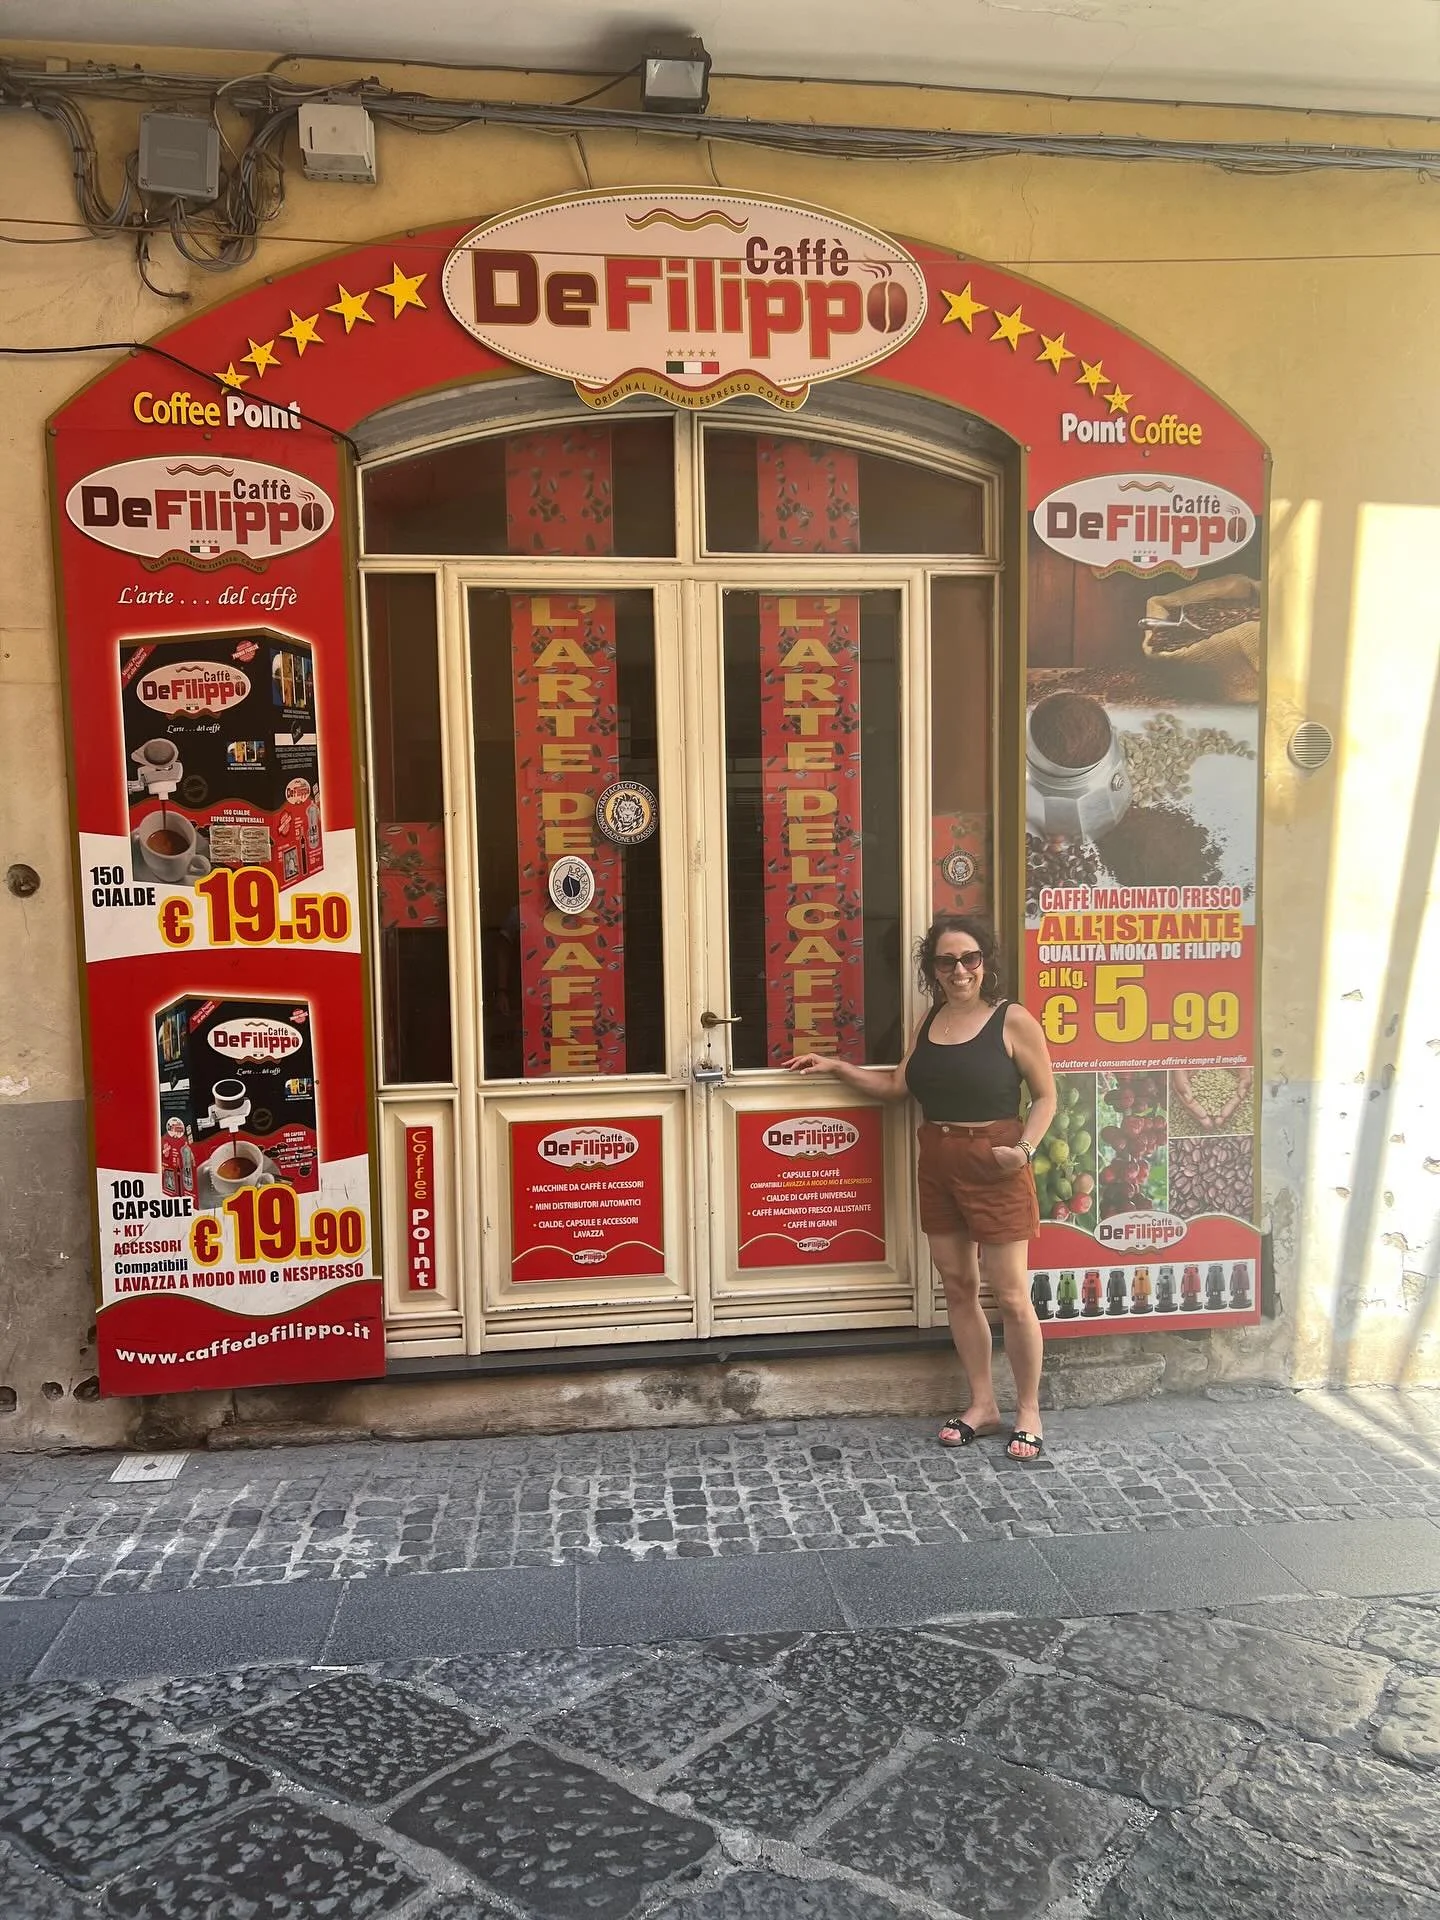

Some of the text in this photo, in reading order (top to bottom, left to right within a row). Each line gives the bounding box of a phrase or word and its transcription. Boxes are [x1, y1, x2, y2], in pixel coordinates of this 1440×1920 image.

[746, 236, 849, 276] Caffè
[594, 381, 796, 409] ORIGINAL ITALIAN ESPRESSO COFFEE
[134, 391, 303, 430] Coffee Point
[1062, 413, 1202, 445] Point Coffee
[233, 478, 291, 499] Caffè
[1172, 494, 1221, 514] Caffè
[117, 585, 174, 604] L'arte
[218, 586, 250, 605] del
[251, 586, 297, 610] caffè
[90, 865, 124, 886] 150
[92, 887, 156, 907] CIALDE
[160, 867, 350, 946] € 19.50
[1041, 886, 1242, 910] CAFFÈ MACINATO FRESCO
[1038, 912, 1242, 943] ALL'ISTANTE
[1039, 942, 1241, 964] QUALITÀ MOKA DE FILIPPO
[1039, 968, 1087, 989] al Kg.
[1042, 964, 1240, 1044] € 5.99
[1050, 1060, 1088, 1069] roduttore
[1098, 1058, 1146, 1067] consumatore
[1147, 1059, 1161, 1068] per
[1188, 1057, 1215, 1066] sempre
[600, 1134, 622, 1143] Caffè
[822, 1124, 843, 1132] Caffè
[411, 1131, 428, 1200] Coffee
[782, 1171, 811, 1179] CAPSULE
[820, 1169, 840, 1177] CAFFÈ
[111, 1179, 144, 1199] 100
[532, 1184, 568, 1193] MACCHINE
[580, 1182, 601, 1191] CAFFÈ
[608, 1181, 644, 1189] ACCESSORI
[783, 1180, 806, 1188] LAVAZZA
[535, 1199, 641, 1211] MINI DISTRIBUTORI AUTOMATICI
[767, 1193, 789, 1202] CIALDE
[799, 1191, 818, 1200] CAFFÈ
[820, 1191, 857, 1199] UNIVERSALI
[112, 1199, 192, 1220] CAPSULE
[752, 1207, 773, 1217] CAFFÈ
[773, 1207, 807, 1216] MACINATO
[808, 1206, 832, 1214] FRESCO
[124, 1224, 145, 1238] KIT
[192, 1185, 364, 1264] € 19.90
[539, 1221, 565, 1229] CIALDE,
[566, 1219, 596, 1228] CAPSULE
[602, 1217, 639, 1226] ACCESSORI
[788, 1219, 807, 1229] CAFFÈ
[817, 1219, 837, 1227] GRANI
[573, 1230, 604, 1238] LAVAZZA
[114, 1239, 182, 1255] ACCESSORI
[411, 1208, 431, 1287] Point
[114, 1258, 188, 1275] Compatibili
[115, 1262, 364, 1292] LAVAZZA A MODO MIO e NESPRESSO
[115, 1321, 371, 1365] www.caffedefilippo.it
